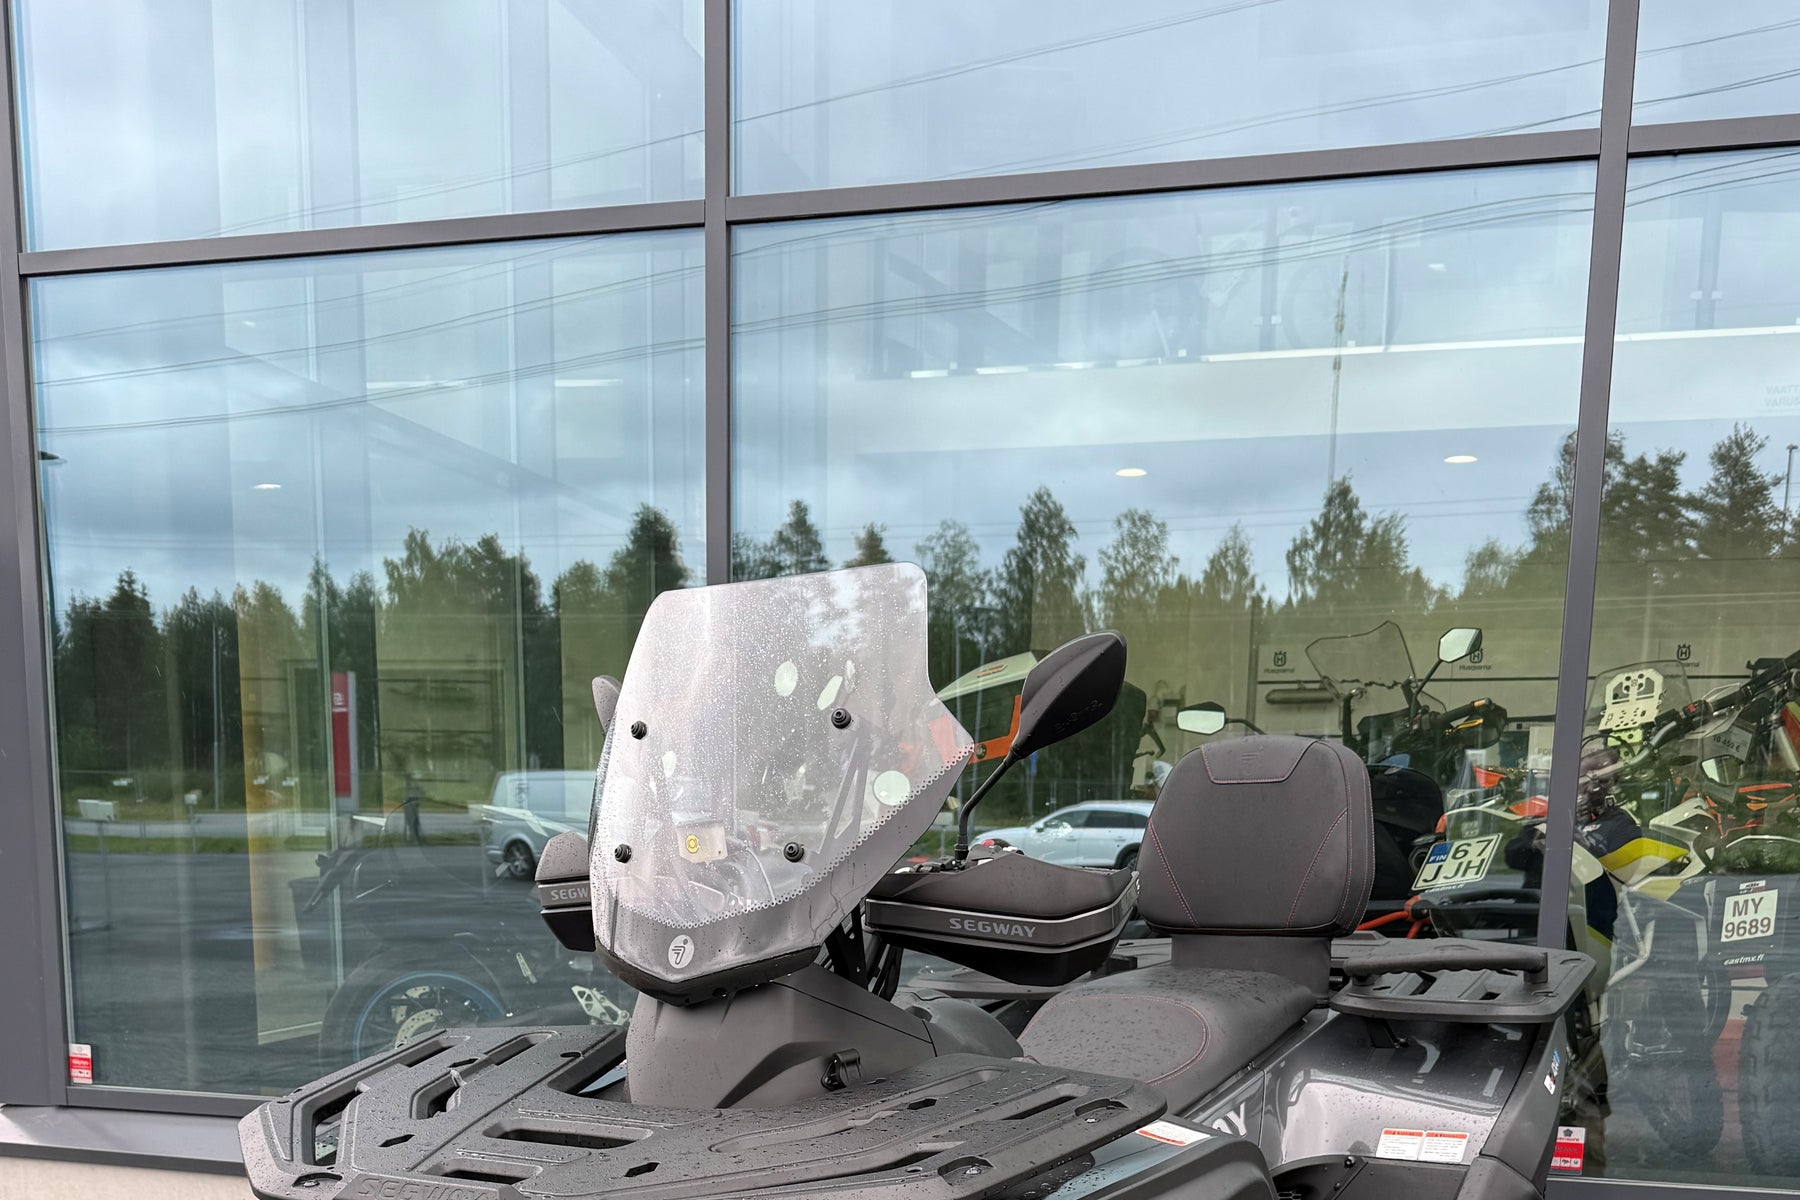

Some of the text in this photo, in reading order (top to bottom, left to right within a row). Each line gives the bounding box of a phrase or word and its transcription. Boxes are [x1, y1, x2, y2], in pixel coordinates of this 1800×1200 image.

[1428, 854, 1447, 863] FIN
[1452, 839, 1494, 860] 67
[1422, 858, 1485, 883] JJH
[1732, 897, 1764, 918] MY
[949, 918, 1036, 938] SEGWAY
[1724, 917, 1772, 939] 9689
